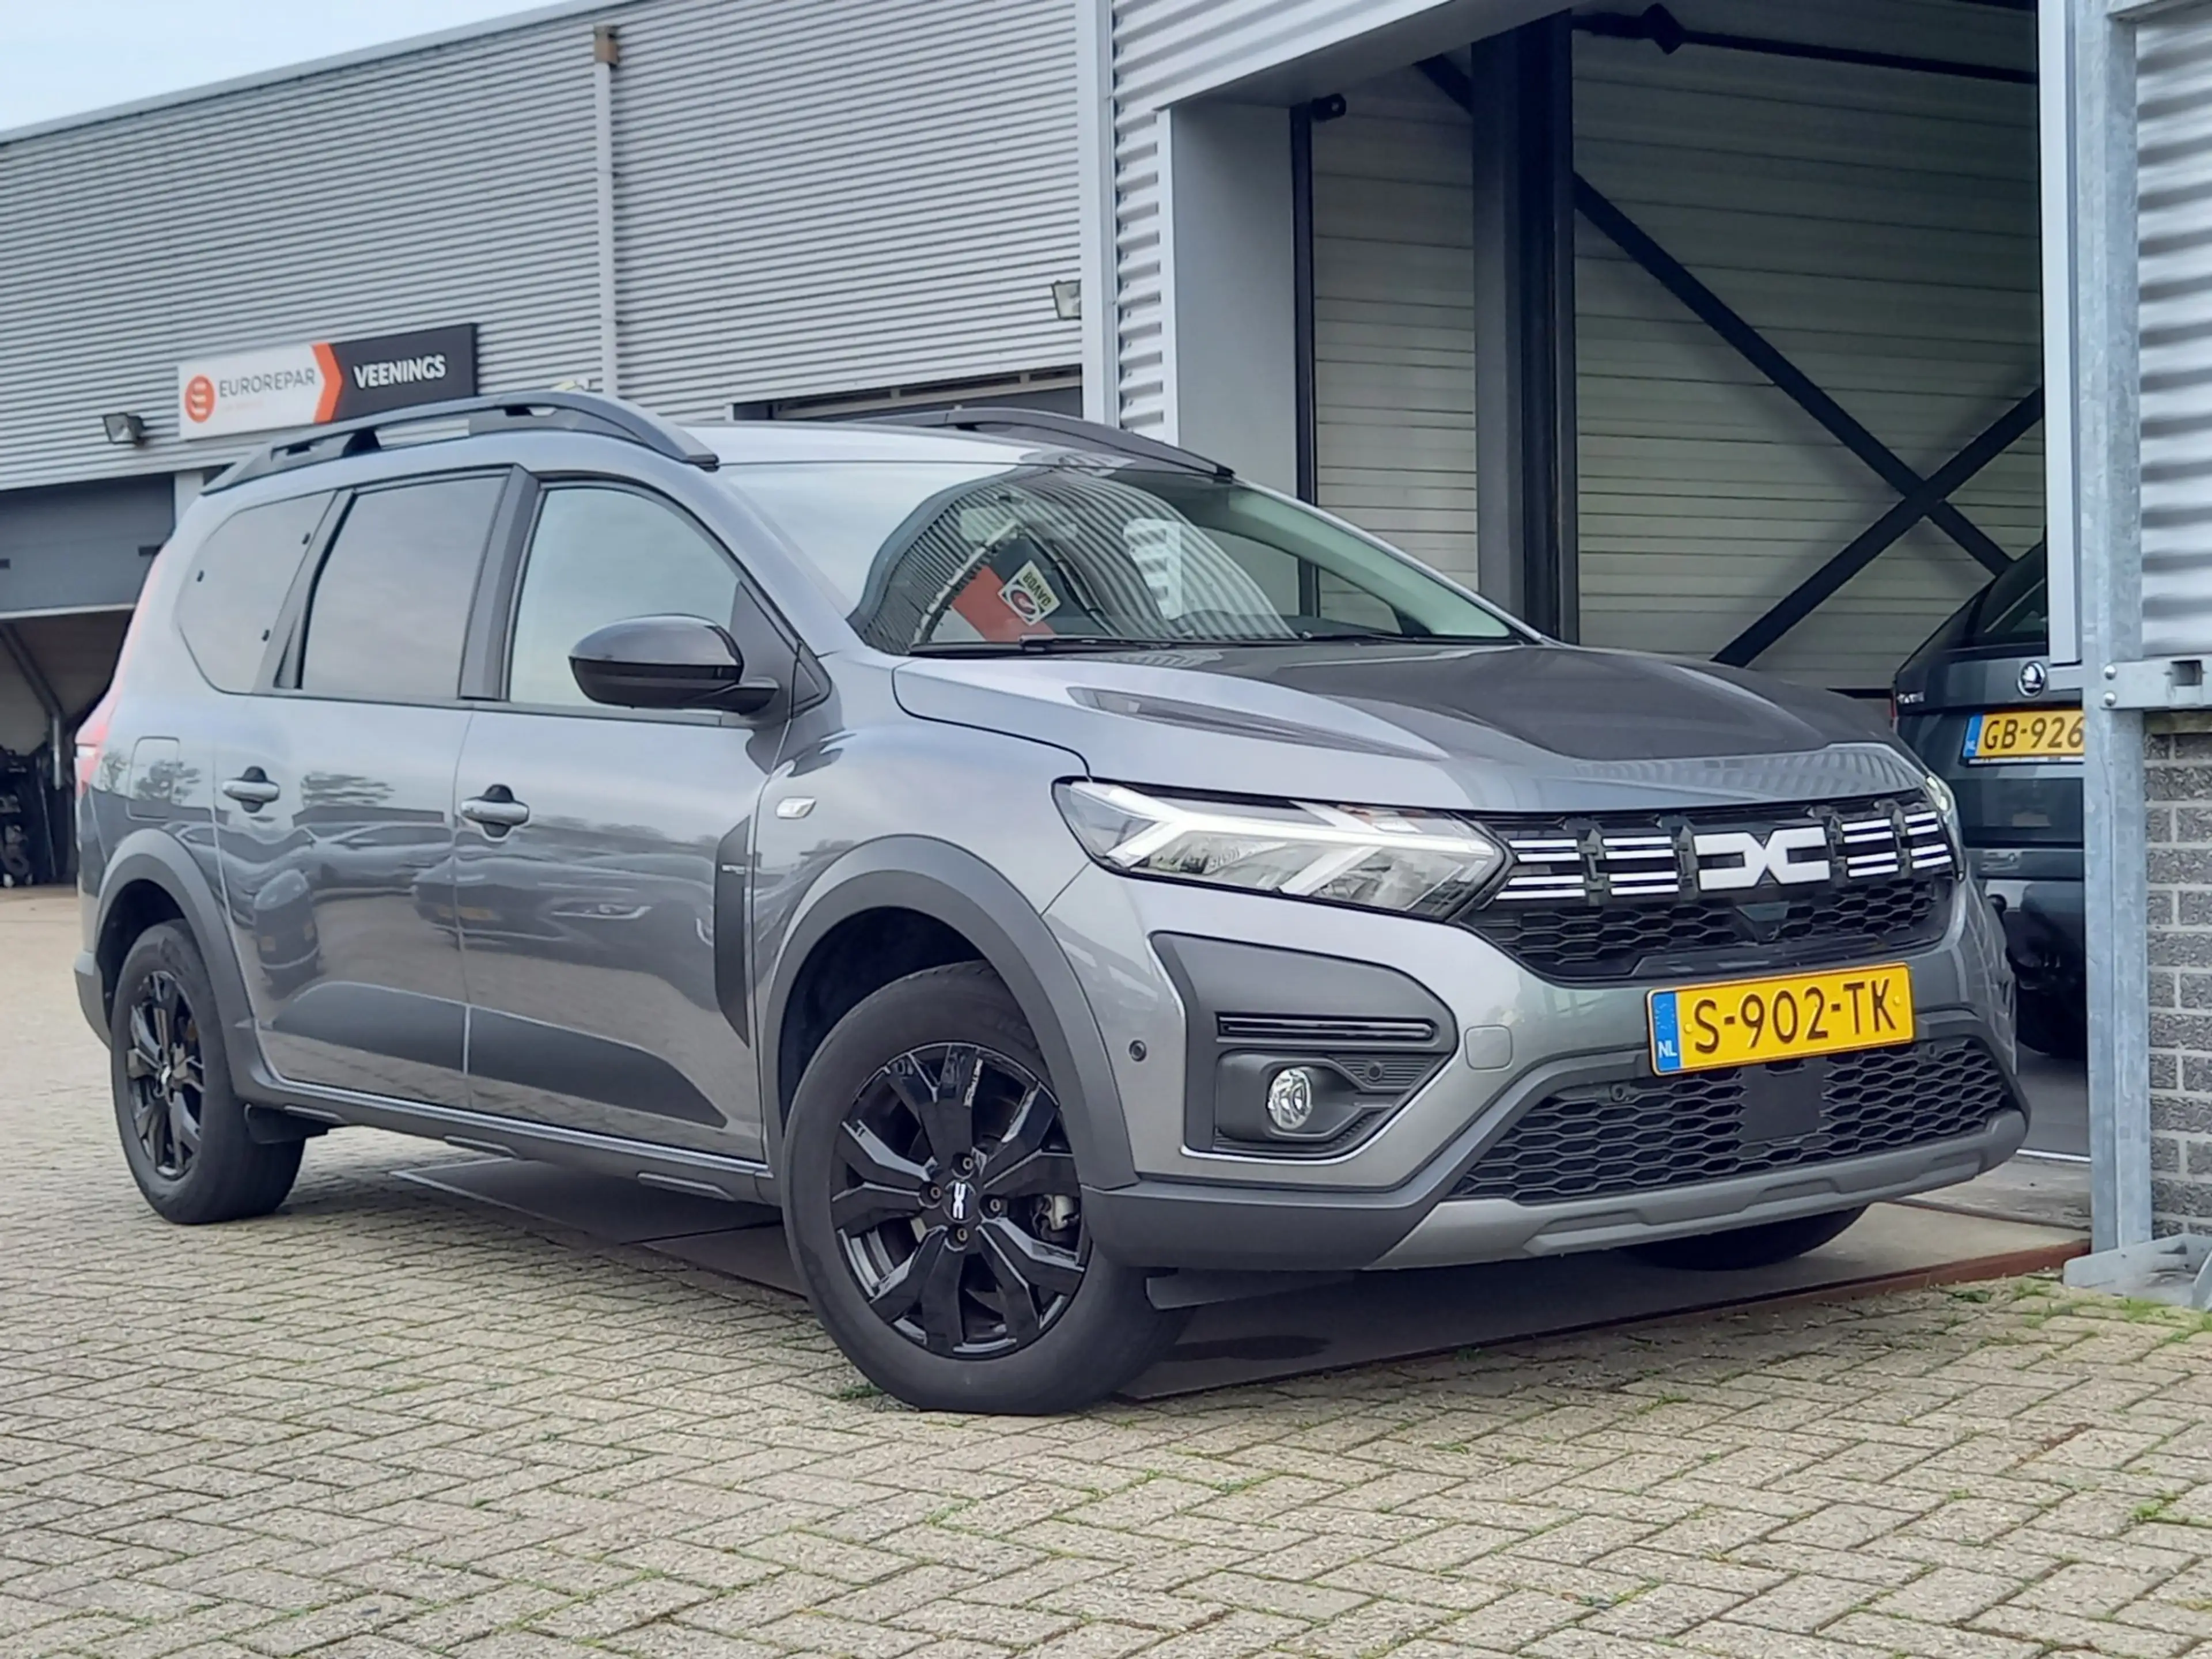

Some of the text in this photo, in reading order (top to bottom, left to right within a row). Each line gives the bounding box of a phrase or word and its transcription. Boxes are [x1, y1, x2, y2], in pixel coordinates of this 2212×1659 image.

[219, 368, 316, 397] EUROREPAR
[353, 354, 446, 389] VEENINGS
[1693, 979, 1897, 1054] S-902-TK
[1658, 1040, 1677, 1058] NL
